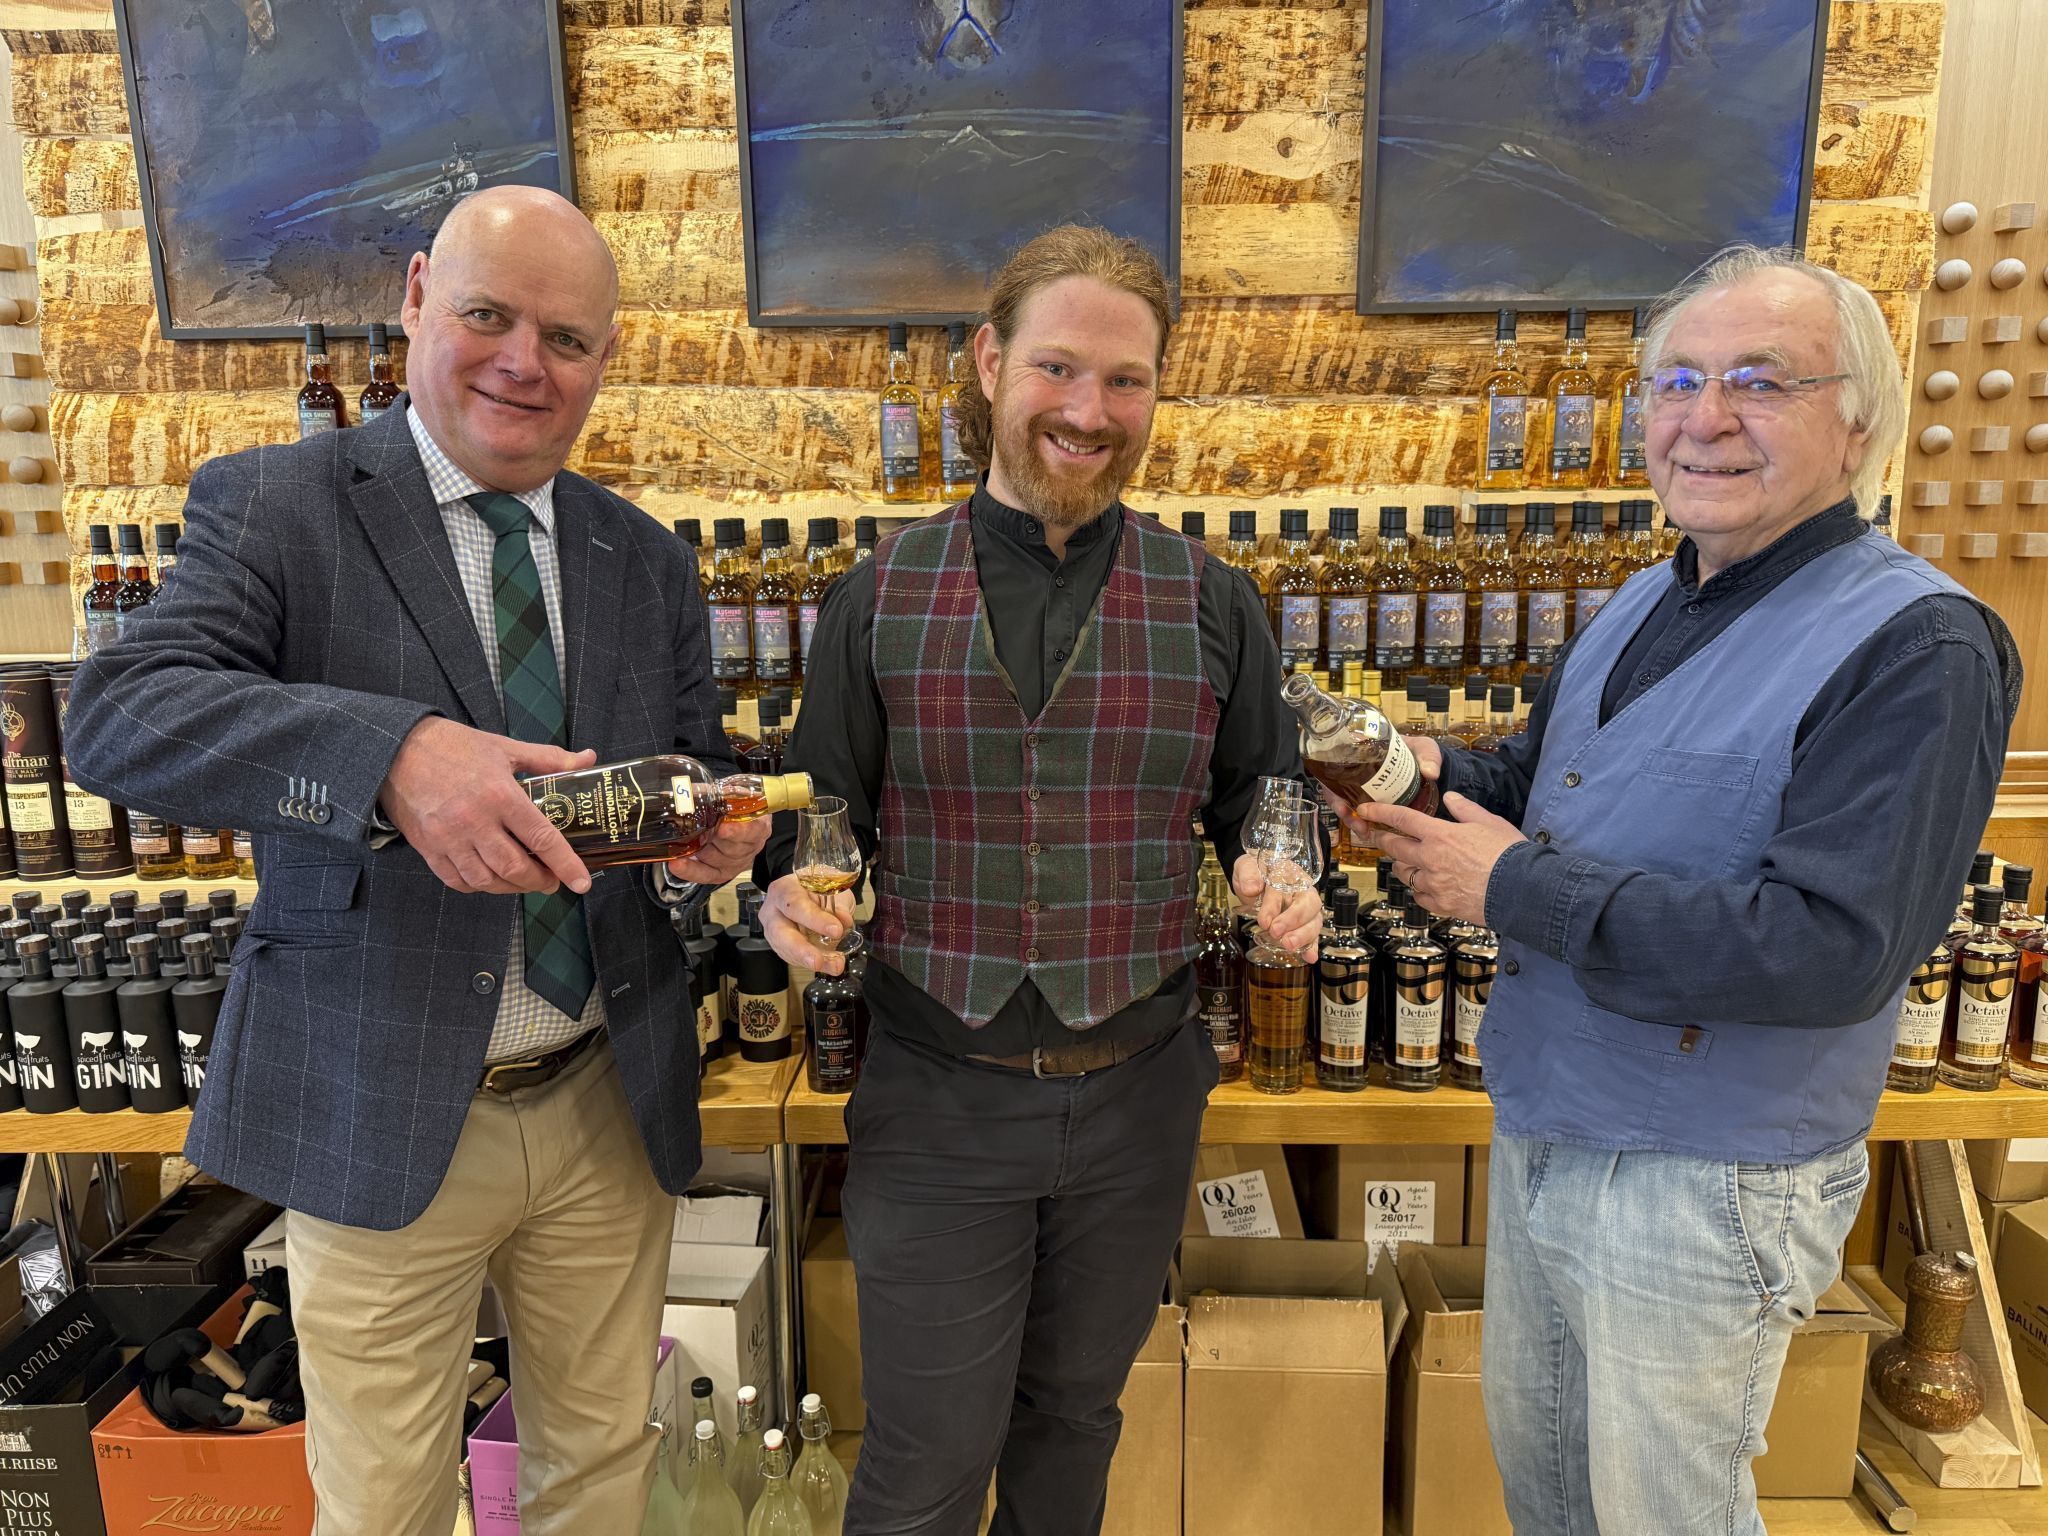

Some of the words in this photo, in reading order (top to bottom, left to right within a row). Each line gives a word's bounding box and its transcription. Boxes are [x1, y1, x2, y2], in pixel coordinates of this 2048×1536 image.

[15, 801, 25, 809] 13
[73, 799, 84, 808] 13
[581, 791, 595, 825] 2014
[602, 770, 619, 843] BALLINDALLOCH
[1324, 1005, 1362, 1018] Octave
[1401, 1006, 1439, 1018] Octave
[1964, 1003, 2007, 1016] Octave
[77, 1053, 98, 1064] spiced
[103, 1051, 122, 1061] fruits
[77, 1059, 128, 1089] GIN
[1221, 1204, 1256, 1219] 26/020
[1381, 1213, 1416, 1222] 26/017
[57, 1312, 96, 1350] NON
[20, 1342, 60, 1380] PLUS
[0, 1489, 50, 1508] NON
[5, 1508, 53, 1527] PLUS
[139, 1494, 286, 1532] Zacapa
